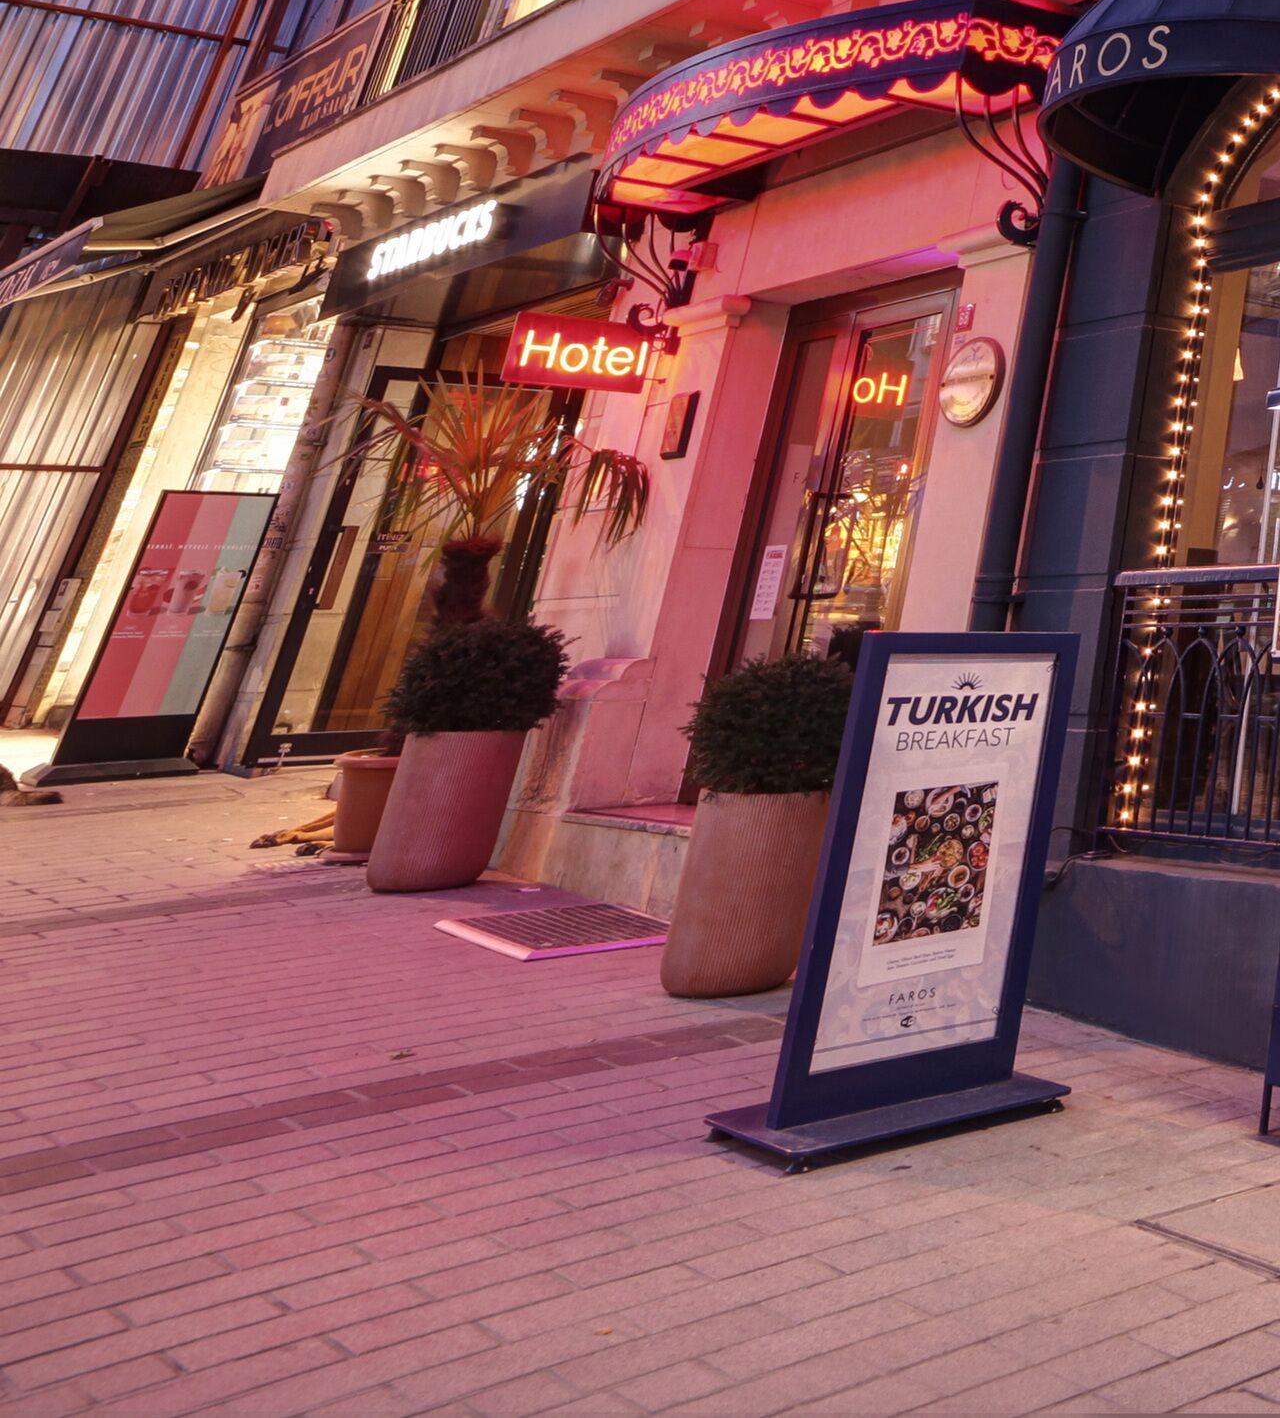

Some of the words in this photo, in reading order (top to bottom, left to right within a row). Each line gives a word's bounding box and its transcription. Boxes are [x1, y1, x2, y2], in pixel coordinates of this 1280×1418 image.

[366, 200, 498, 281] STARBUCKS
[518, 329, 649, 377] Hotel
[886, 693, 1040, 726] TURKISH
[896, 727, 1016, 751] BREAKFAST
[888, 987, 936, 1005] FAROS
